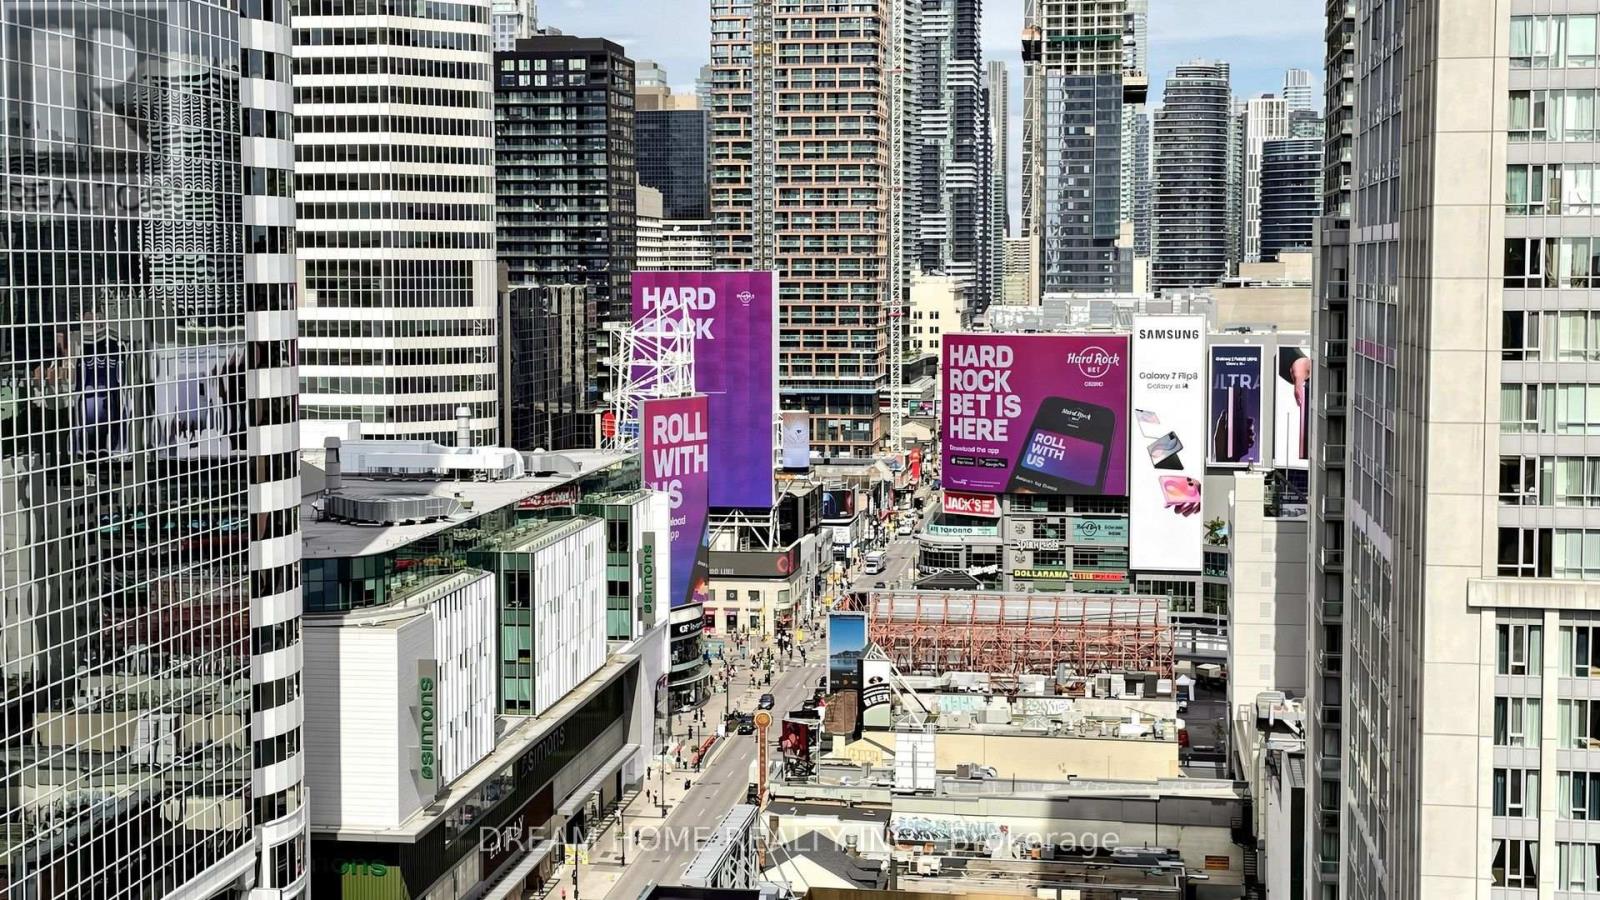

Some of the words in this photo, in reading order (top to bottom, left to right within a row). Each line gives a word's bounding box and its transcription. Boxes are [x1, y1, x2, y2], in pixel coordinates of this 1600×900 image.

[642, 286, 716, 311] HARD
[1139, 329, 1199, 340] SAMSUNG
[949, 344, 1014, 368] HARD
[1067, 351, 1092, 365] Hard
[1094, 352, 1120, 367] Rock
[949, 369, 1012, 393] ROCK
[1139, 372, 1170, 381] Galaxy
[949, 393, 990, 417] BET
[997, 395, 1022, 419] IS
[653, 411, 708, 445] ROLL
[949, 417, 1009, 442] HERE
[1034, 433, 1067, 449] ROLL
[653, 443, 708, 479] WITH
[1026, 453, 1045, 468] US
[1031, 443, 1065, 461] WITH
[945, 496, 982, 512] JACK'S
[670, 529, 680, 542] pp
[643, 544, 653, 604] simons
[1014, 569, 1069, 578] DOLLARAMA
[863, 693, 890, 707] BEER
[420, 677, 434, 766] simons
[527, 725, 566, 772] simons
